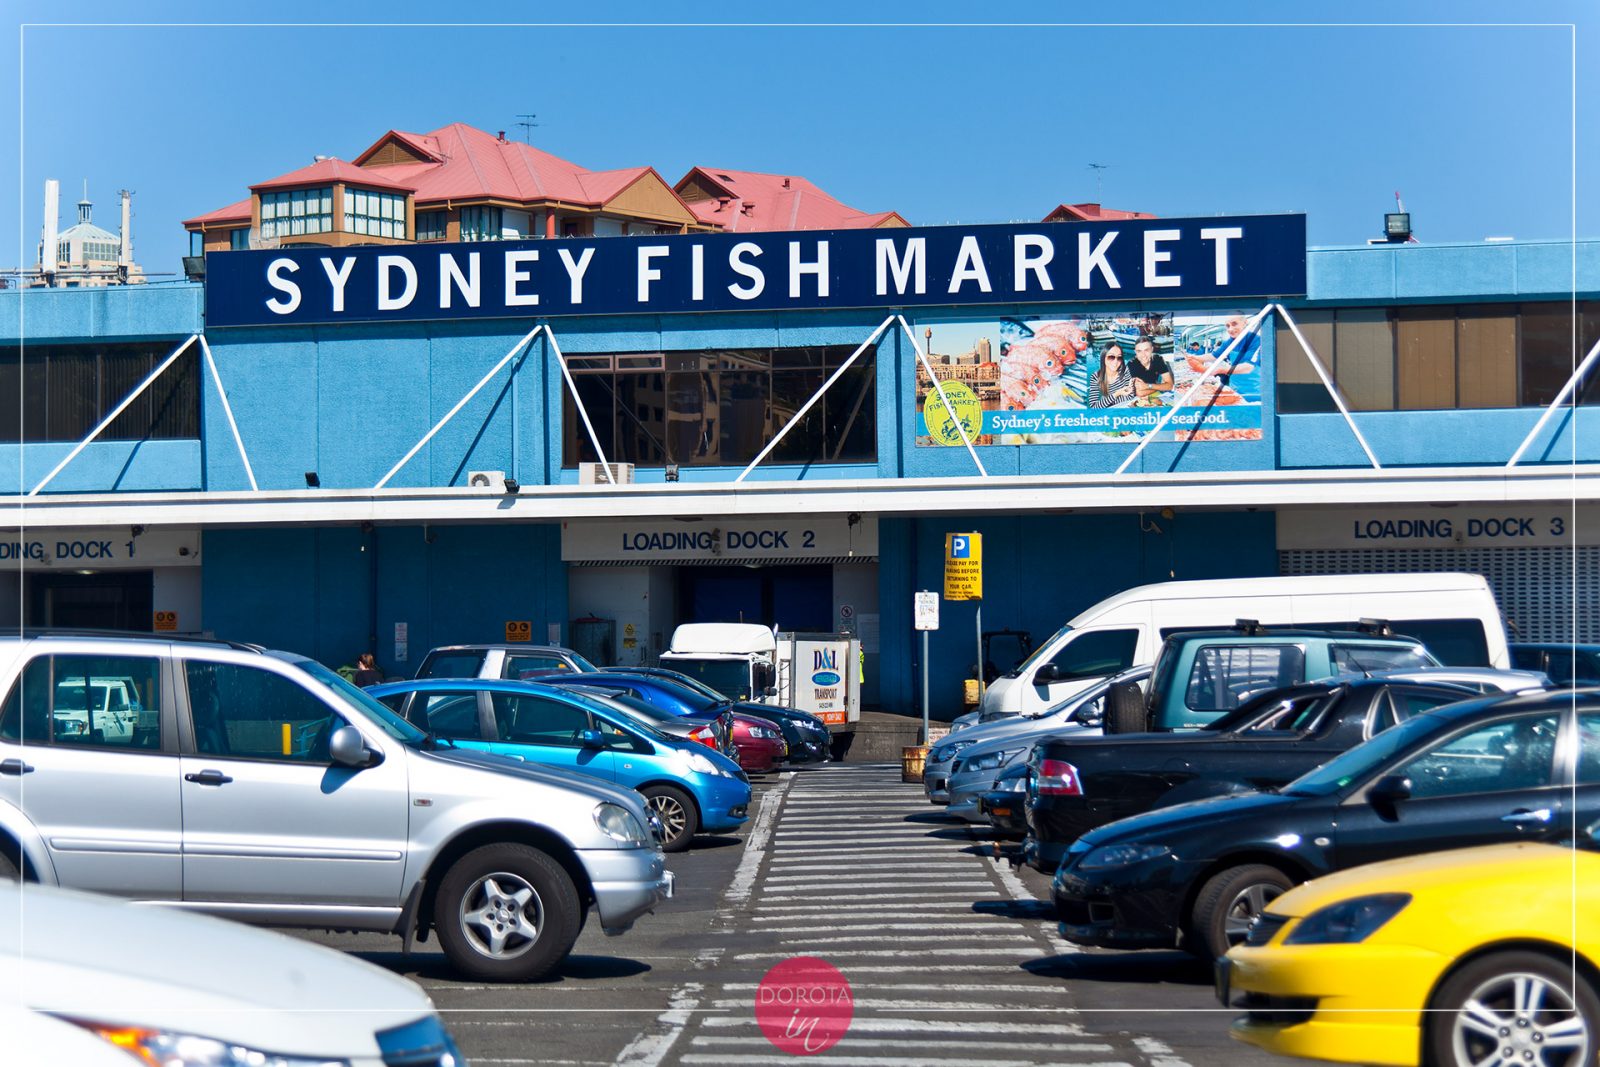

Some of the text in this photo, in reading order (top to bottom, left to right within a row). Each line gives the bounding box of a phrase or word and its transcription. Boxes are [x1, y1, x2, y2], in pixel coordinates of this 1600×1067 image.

[265, 227, 1243, 314] SYDNEY FISH MARKET
[935, 391, 967, 401] SDNEY
[1054, 413, 1109, 427] freshest
[1171, 410, 1230, 424] seafood.
[1354, 516, 1565, 539] LOADING DOCK 3
[623, 530, 815, 550] LOADING DOCK 2
[953, 538, 966, 556] P
[0, 541, 134, 559] DING DOCK 1
[813, 647, 838, 671] D&L
[814, 688, 837, 699] TRANSPORT
